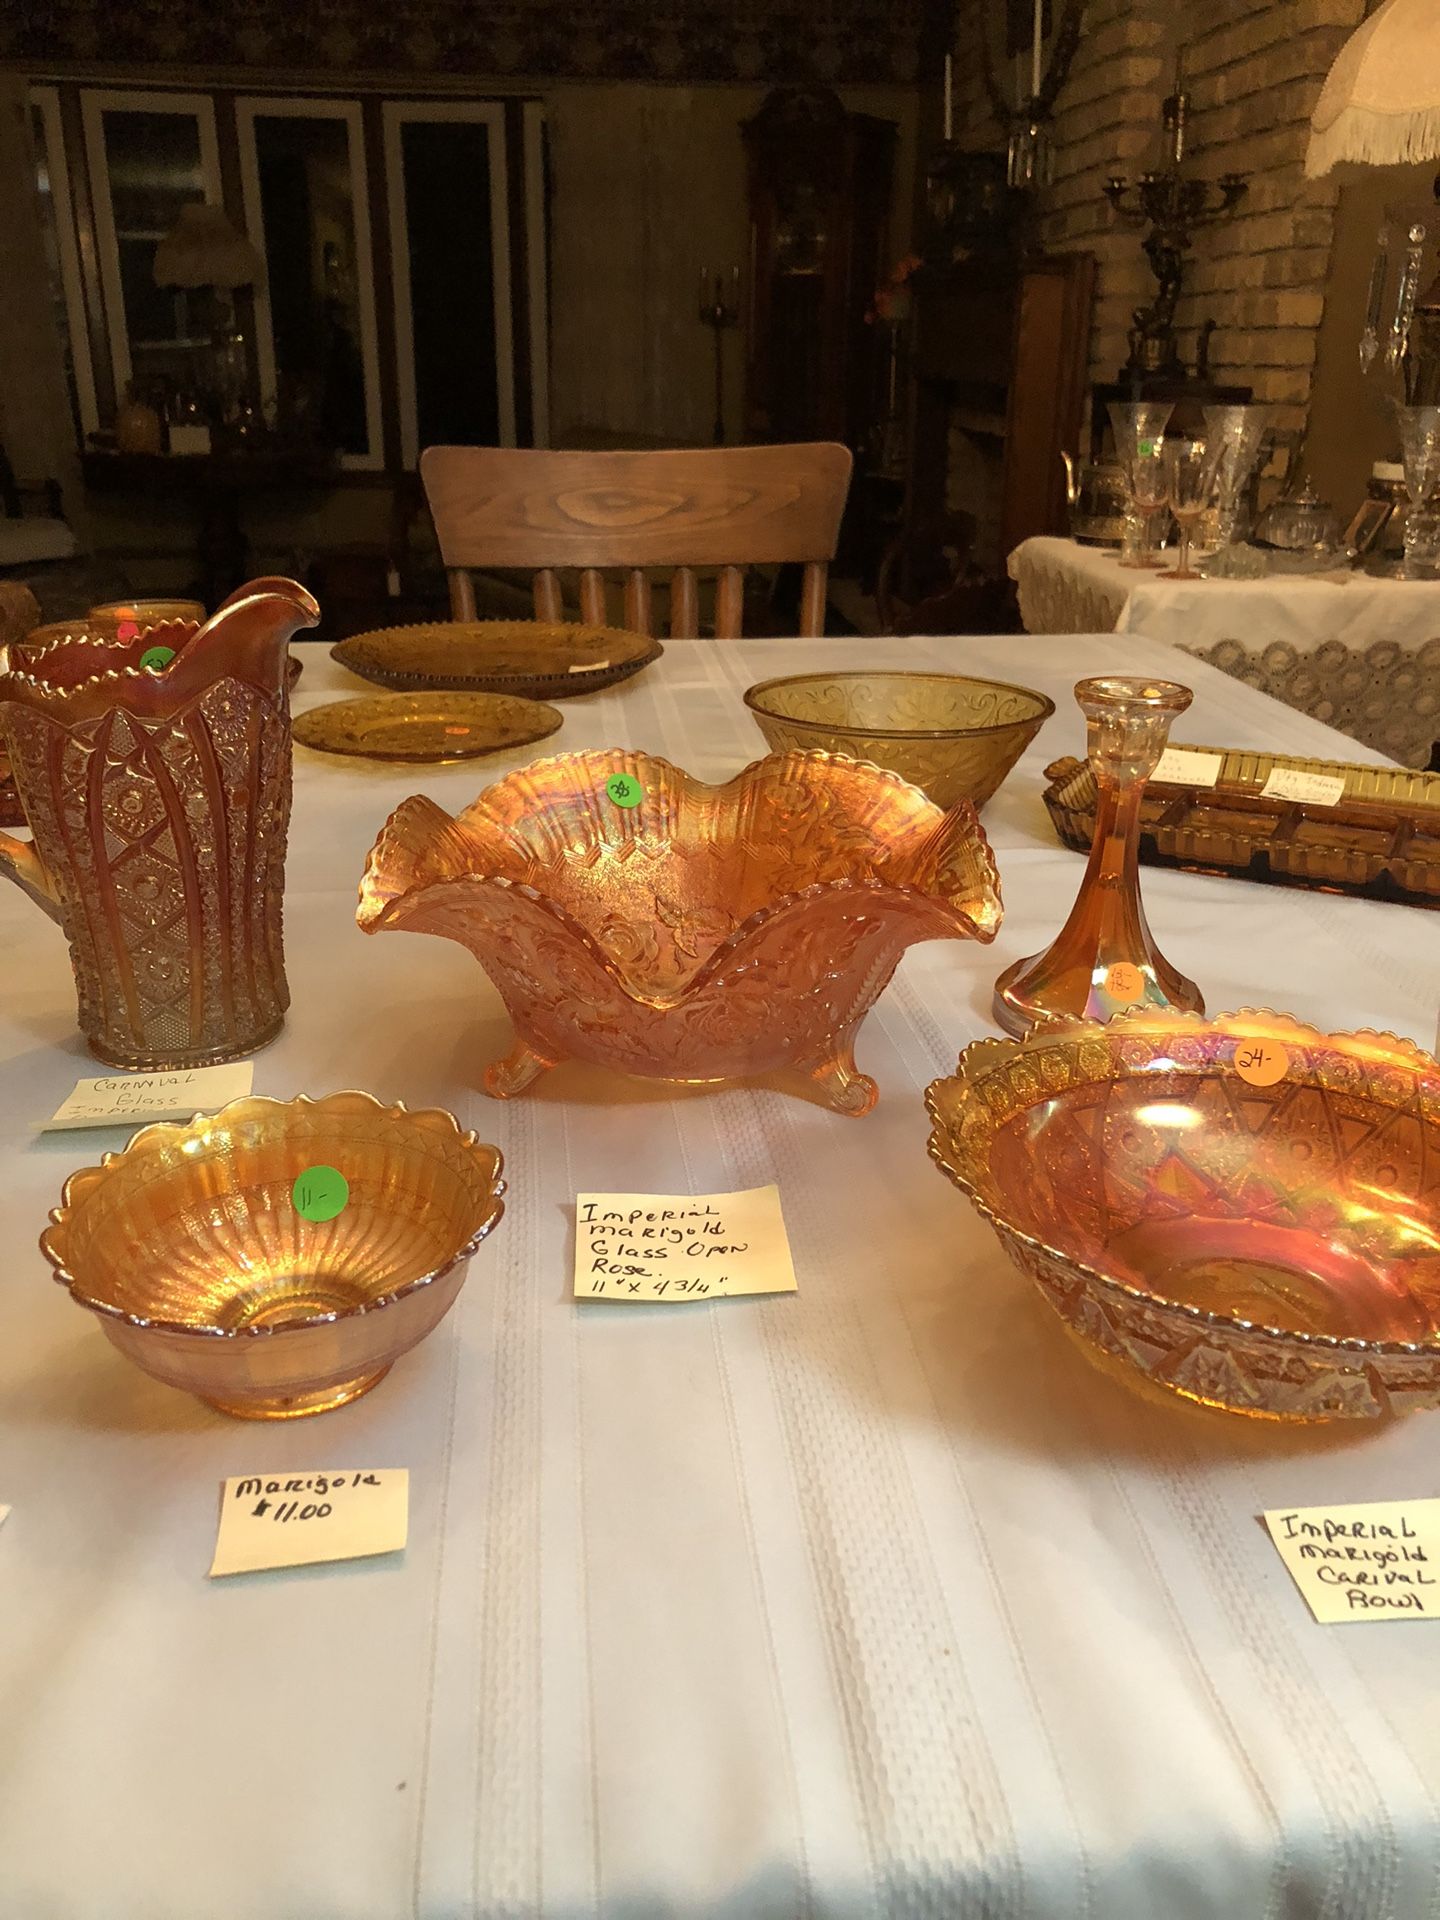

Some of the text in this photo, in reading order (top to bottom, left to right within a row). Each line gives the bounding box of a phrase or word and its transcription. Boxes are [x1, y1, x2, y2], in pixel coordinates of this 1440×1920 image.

[591, 1240, 748, 1259] Glass Open
[251, 1499, 333, 1523] $11.00
[1345, 1588, 1425, 1612] Bowl
